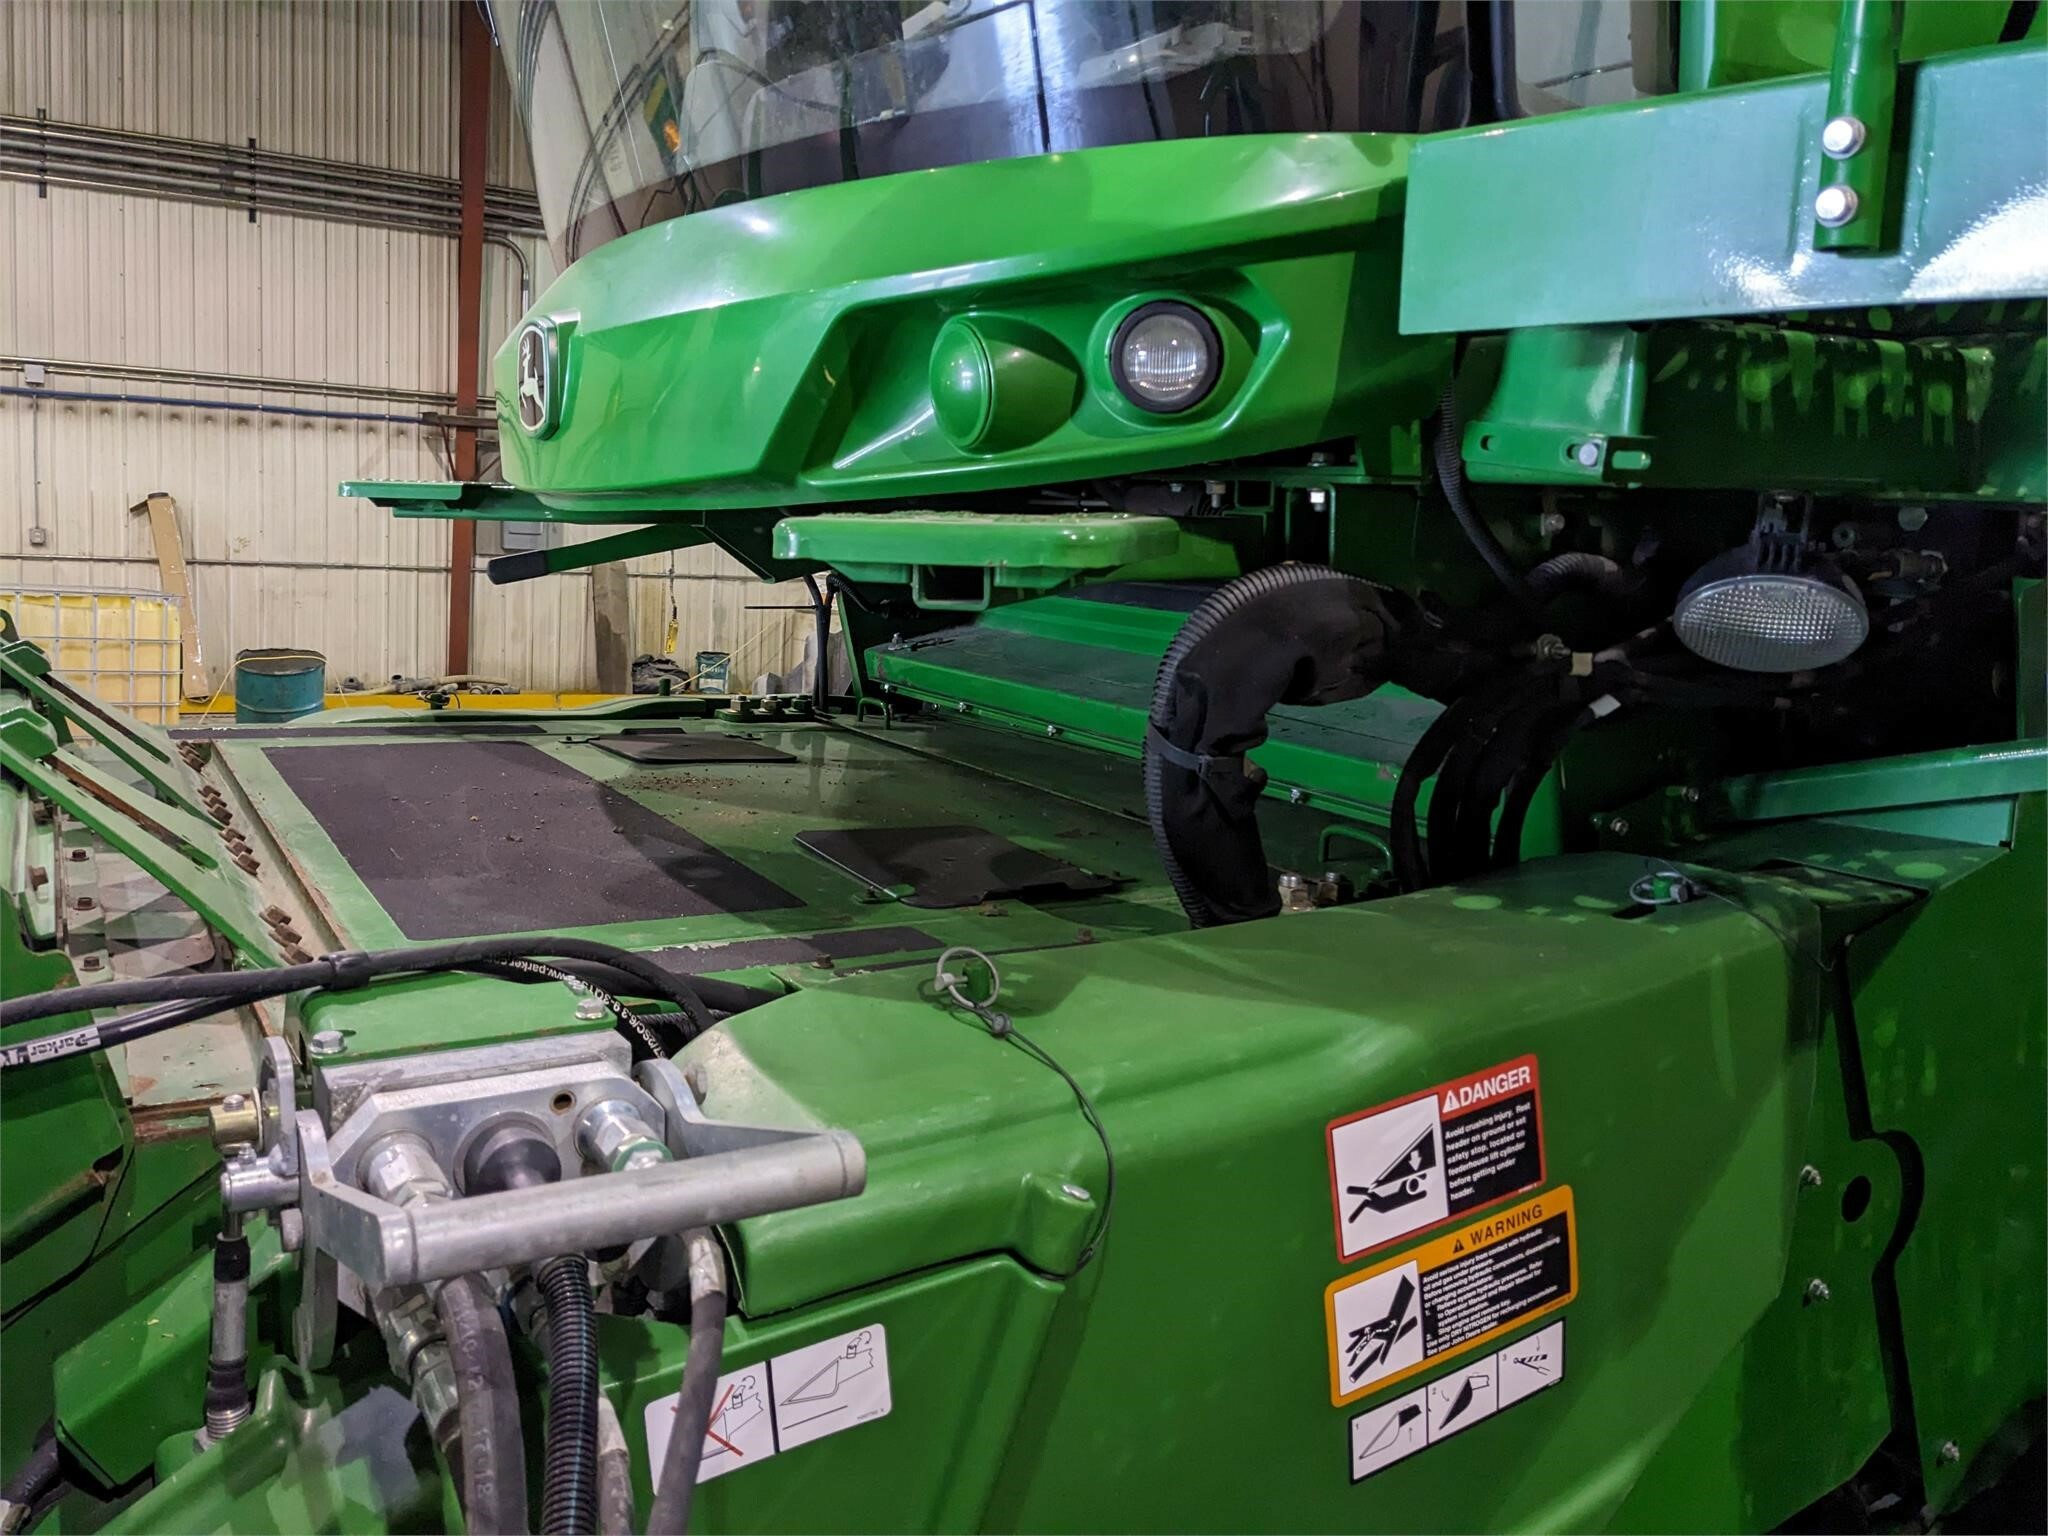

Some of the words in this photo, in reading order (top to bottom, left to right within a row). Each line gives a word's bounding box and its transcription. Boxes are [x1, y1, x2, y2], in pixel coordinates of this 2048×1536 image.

[30, 1033, 88, 1056] Parker
[1459, 1066, 1531, 1107] DANGER
[1445, 1126, 1464, 1139] Avoid
[1465, 1116, 1493, 1133] crushing
[1515, 1102, 1530, 1114] Rest
[1446, 1137, 1470, 1152] header
[1471, 1134, 1481, 1142] on
[1482, 1124, 1506, 1140] ground
[1515, 1117, 1526, 1126] set
[1447, 1151, 1469, 1165] safety
[1490, 1134, 1515, 1148] located
[1448, 1155, 1489, 1176] feederhouse
[1490, 1151, 1499, 1160] lift
[1500, 1142, 1525, 1158] cylinder
[1449, 1175, 1471, 1189] before
[1472, 1166, 1496, 1182] getting
[1497, 1158, 1516, 1171] under
[1470, 1203, 1544, 1246] WARNING
